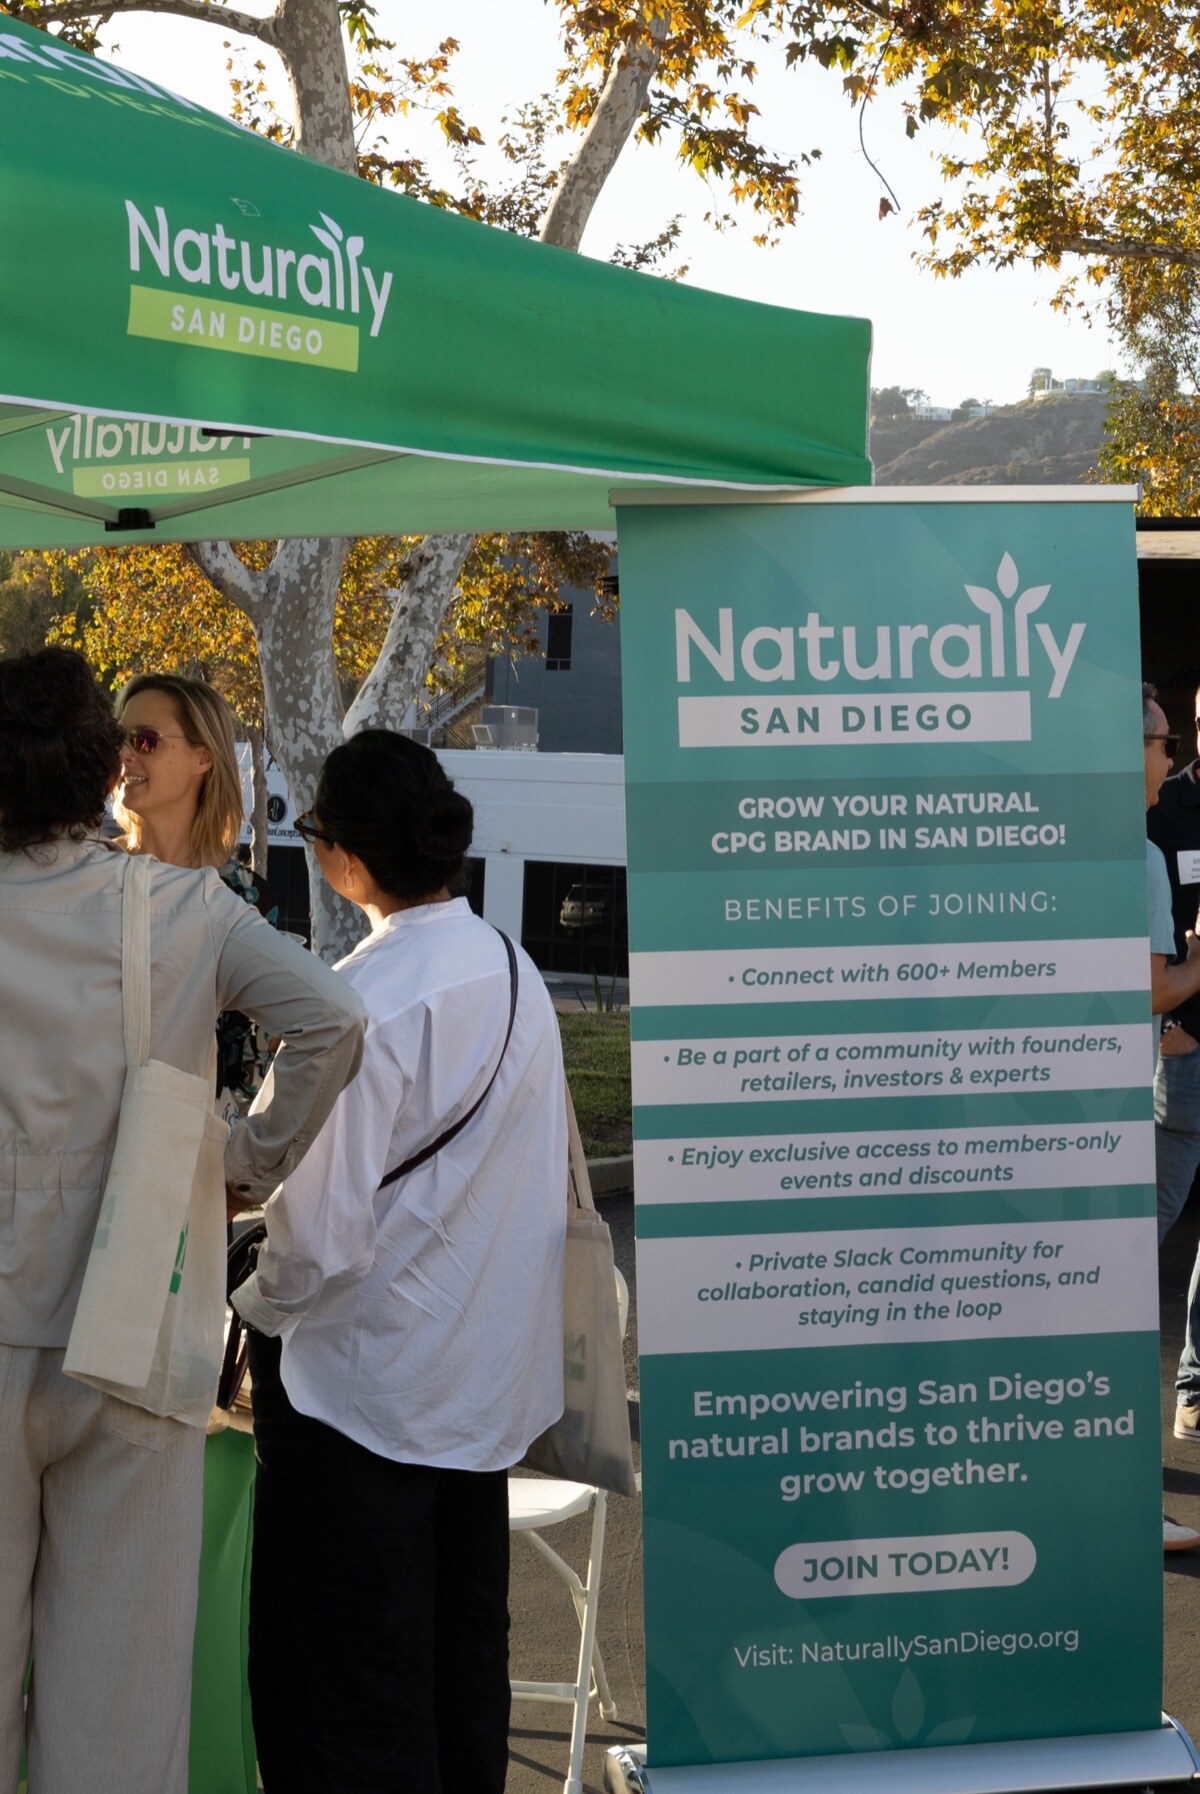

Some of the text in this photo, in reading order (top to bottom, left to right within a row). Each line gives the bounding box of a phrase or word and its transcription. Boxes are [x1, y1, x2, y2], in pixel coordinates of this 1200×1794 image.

[124, 200, 393, 338] Naturally
[171, 304, 325, 355] SAN DIEGO
[674, 584, 1087, 699] Naturally
[741, 704, 971, 734] SAN DIEGO
[739, 792, 1039, 819] GROW YOUR NATURAL
[712, 824, 1065, 853] CPG BRAND IN SAN DIEGO!
[725, 891, 1056, 920] BENEFITS OF JOINING:
[742, 960, 1056, 986] Connect with 600+ Members
[677, 1034, 1121, 1068] Be a part of a community with founders,
[741, 1065, 1050, 1092] retailers, investors & experts
[682, 1131, 1121, 1169] Enjoy exclusive access to members-only
[781, 1165, 1013, 1190] events and discounts
[749, 1241, 1063, 1271] Private Slack Community for
[698, 1266, 1100, 1303] collaboration, candid questions, and
[799, 1300, 1002, 1328] staying in the loop
[694, 1381, 906, 1420] Empowering
[919, 1380, 976, 1405] San
[669, 1410, 1133, 1459] natural brands to thrive and
[781, 1459, 1027, 1501] grow together.
[803, 1547, 1008, 1582] JOIN TODAY!
[735, 1630, 1078, 1667] Visit: NaturallySanDiego.org
